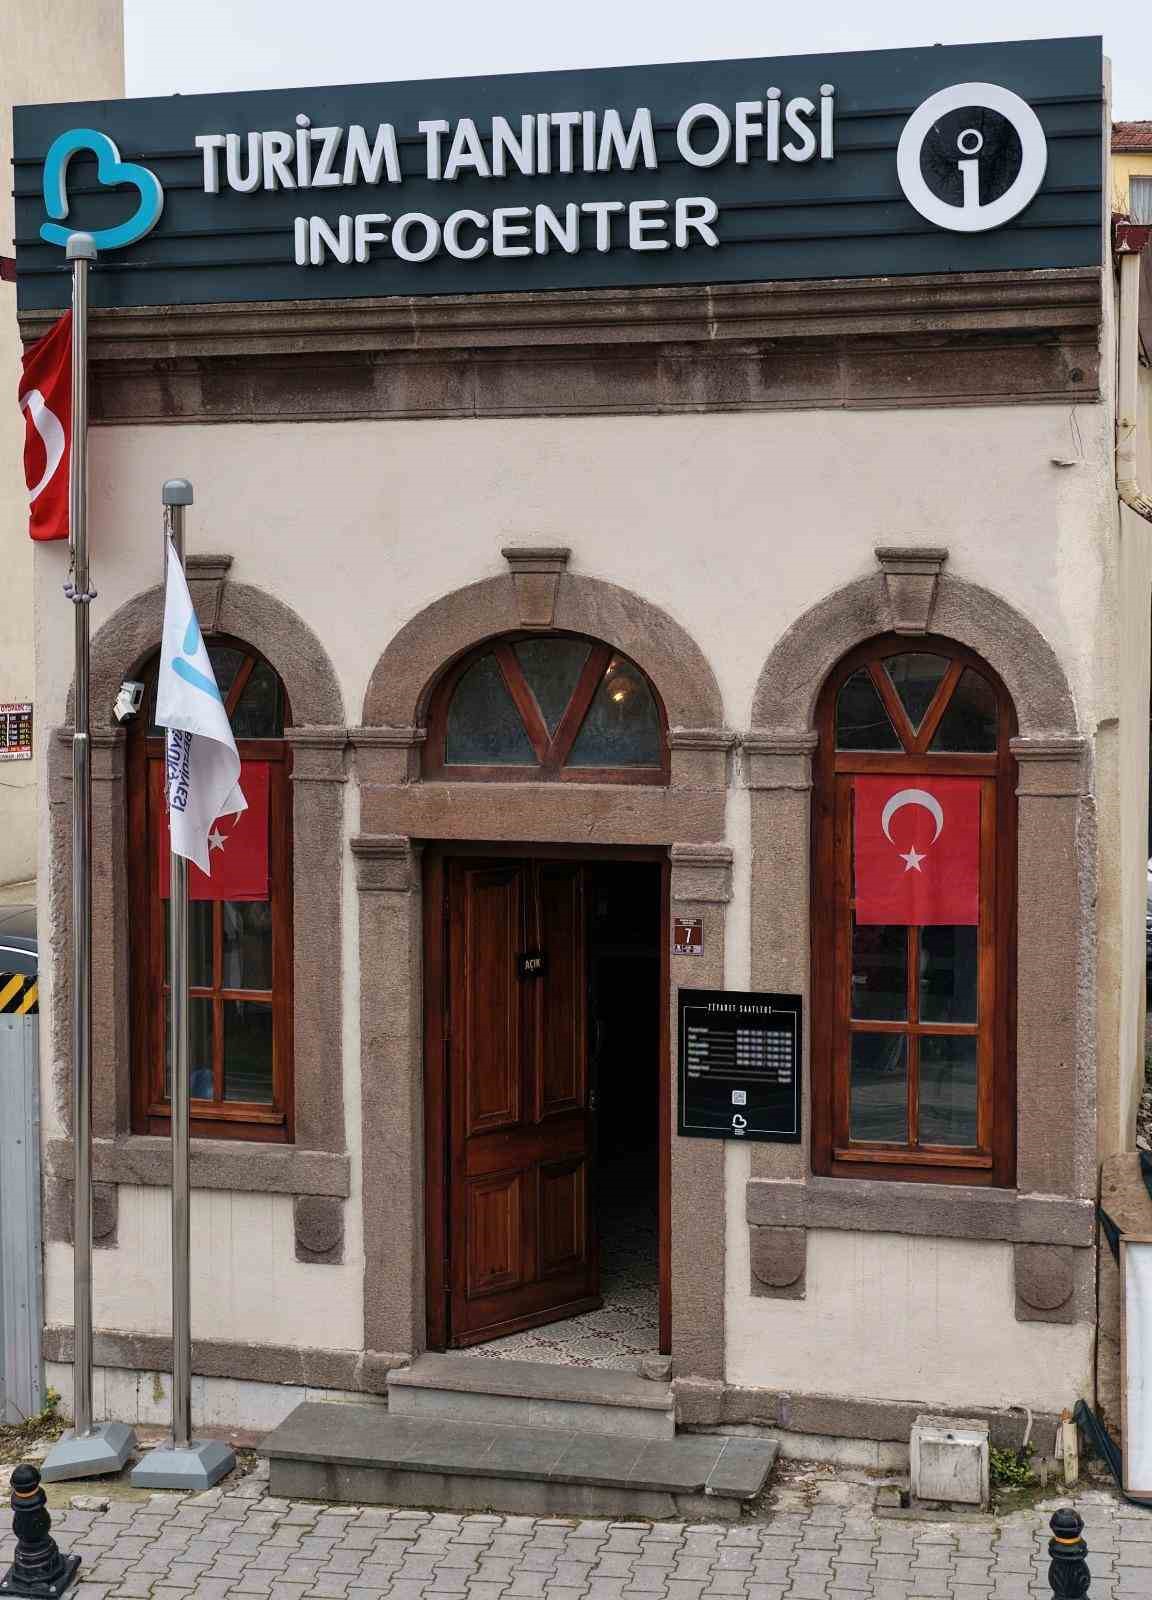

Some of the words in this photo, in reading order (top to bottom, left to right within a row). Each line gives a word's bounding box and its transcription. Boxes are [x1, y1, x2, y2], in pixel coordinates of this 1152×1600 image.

[194, 113, 402, 193] TURİZM
[418, 107, 658, 180] TANITIM
[294, 196, 719, 266] INFOCENTER
[684, 927, 692, 944] 7
